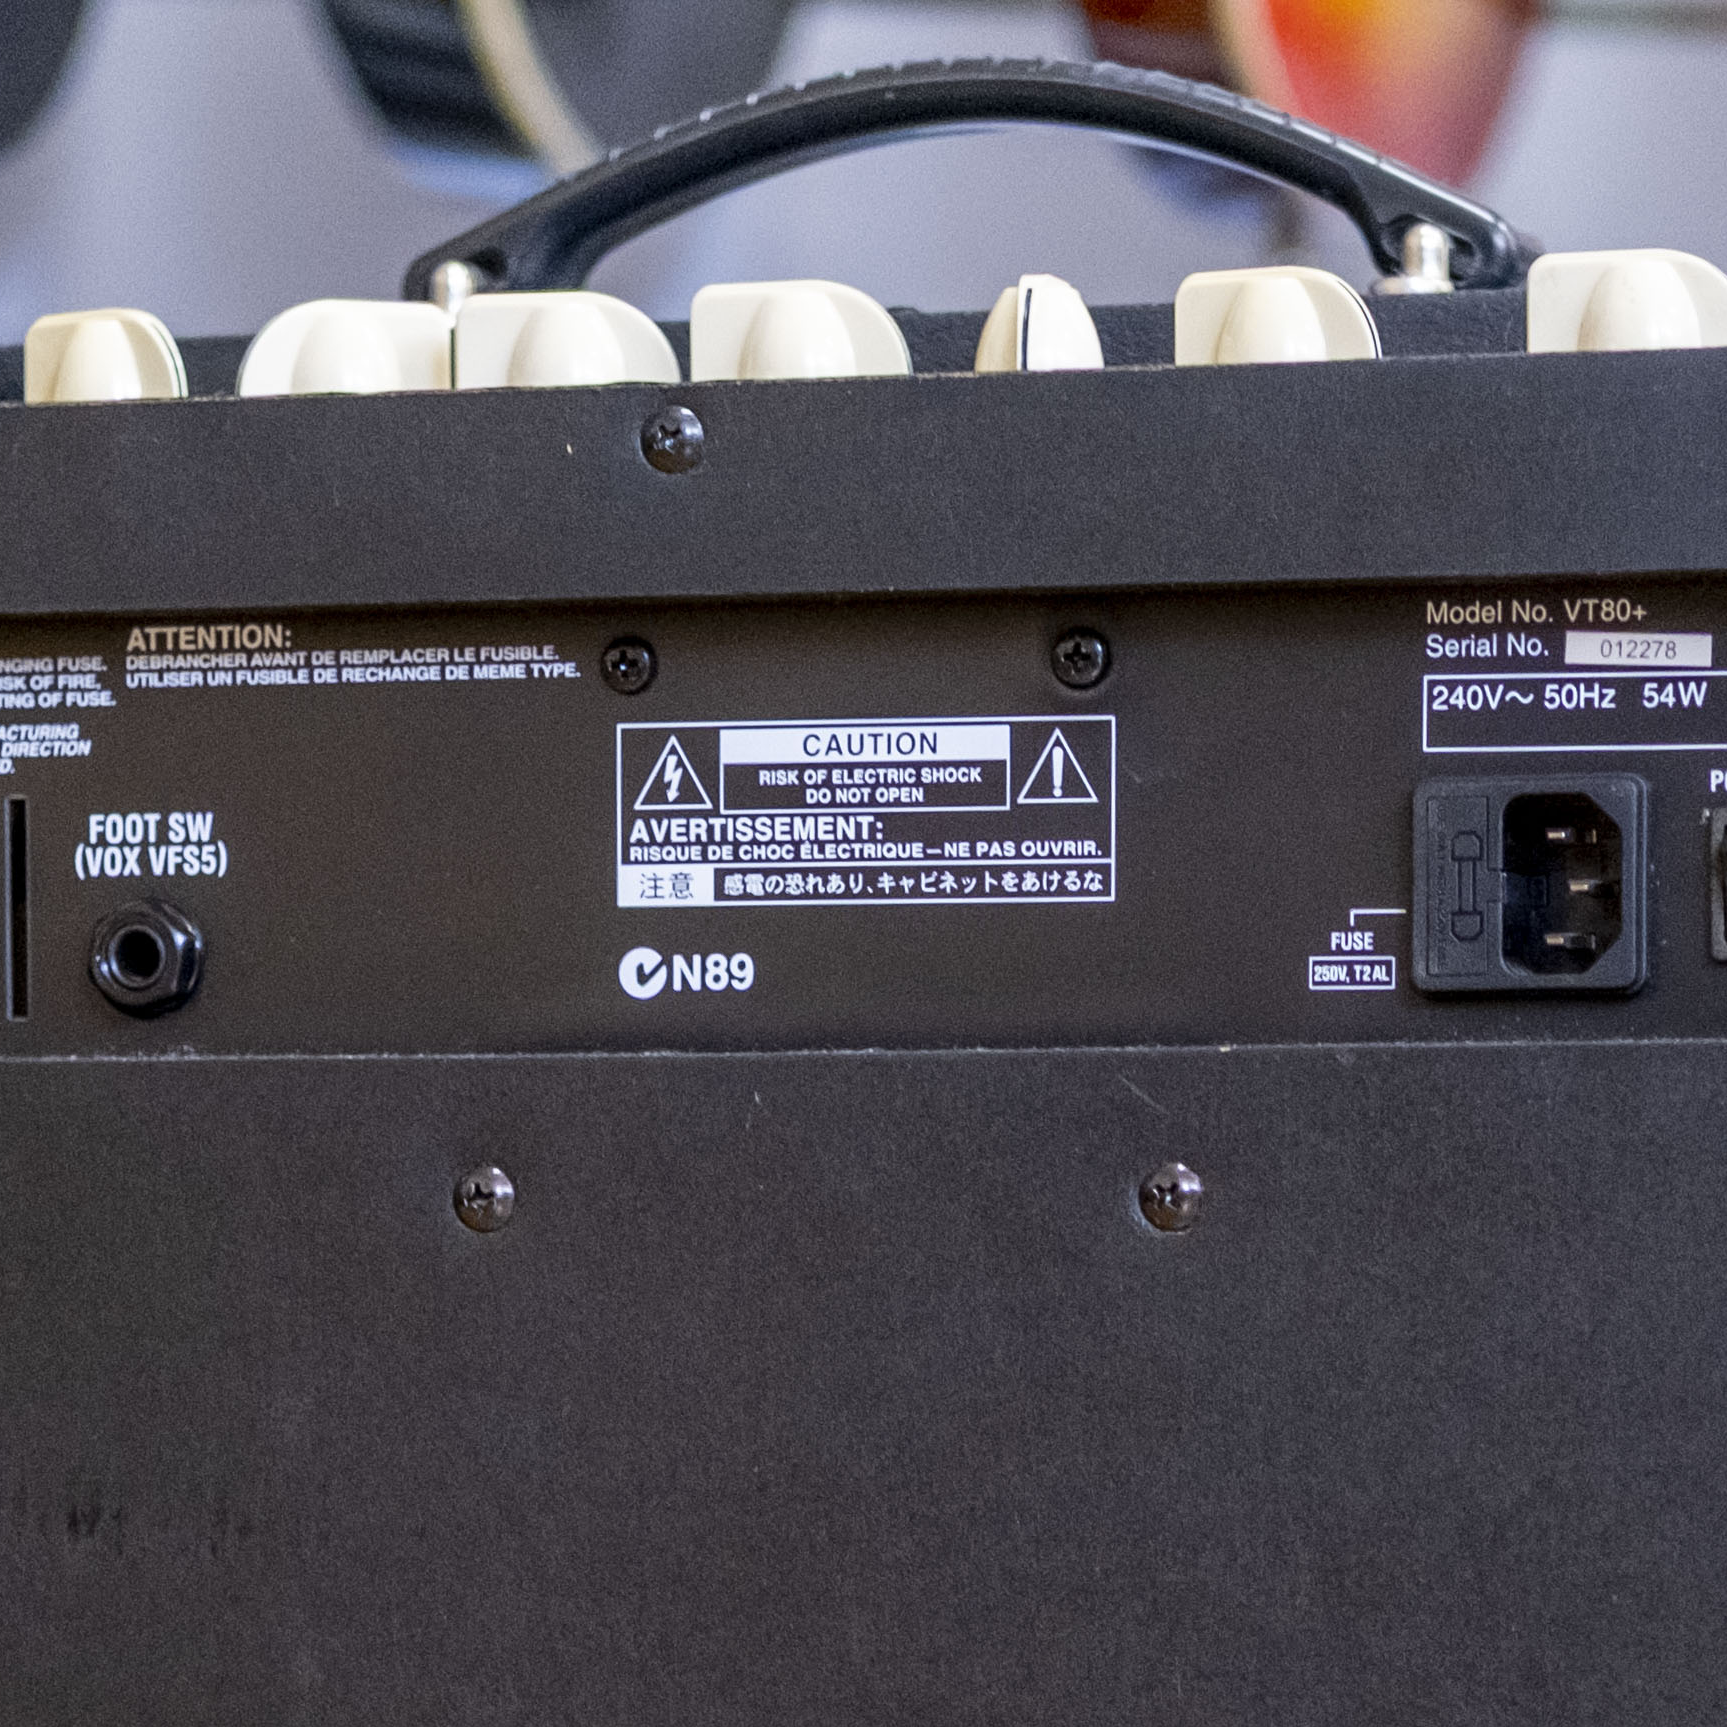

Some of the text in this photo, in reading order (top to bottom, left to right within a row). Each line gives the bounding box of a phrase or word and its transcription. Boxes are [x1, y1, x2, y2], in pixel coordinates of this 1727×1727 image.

[1425, 597, 1648, 625] Model No. VT80+
[126, 624, 292, 652] ATTENTION:
[1426, 632, 1549, 659] Serial No.
[1600, 638, 1678, 660] 012278
[57, 655, 108, 673] FUSE.
[249, 651, 307, 669] AVANT
[311, 650, 336, 667] DE
[340, 646, 450, 666] REMPLACER
[453, 646, 477, 663] LE
[480, 644, 560, 663] FUSIBLE.
[29, 673, 55, 690] OF
[57, 672, 102, 691] FIRE,
[126, 670, 204, 689] UTILISER
[206, 669, 233, 687] UN
[235, 667, 310, 686] FUSIBLE
[313, 667, 338, 684] DE
[341, 664, 442, 683] RECHANGE
[445, 664, 470, 680] DE
[530, 661, 582, 679] TYPE.
[38, 690, 64, 708] OF
[65, 689, 117, 707] FUSE.
[1543, 681, 1616, 710] 50Hz
[1642, 680, 1708, 708] 54W
[0, 738, 92, 757] DIRECTION
[802, 731, 938, 757] CAUTION
[759, 766, 983, 787] RISK OF ELECTRIC SHOCK
[805, 786, 925, 805] DO NOT OPEN
[88, 812, 214, 845] FOOT SW
[629, 814, 884, 844] AVERTISSEMENT:
[74, 842, 228, 880] (VOX VFS5)
[629, 845, 703, 862] RISQUE
[707, 844, 734, 861] DE
[738, 843, 795, 861] CHOC
[975, 840, 1016, 857] PAS
[1020, 839, 1102, 857] OUVRIR.
[639, 872, 695, 900] 注意
[1330, 931, 1374, 951] FUSE
[672, 953, 755, 993] N89
[1313, 965, 1350, 983] 250V,
